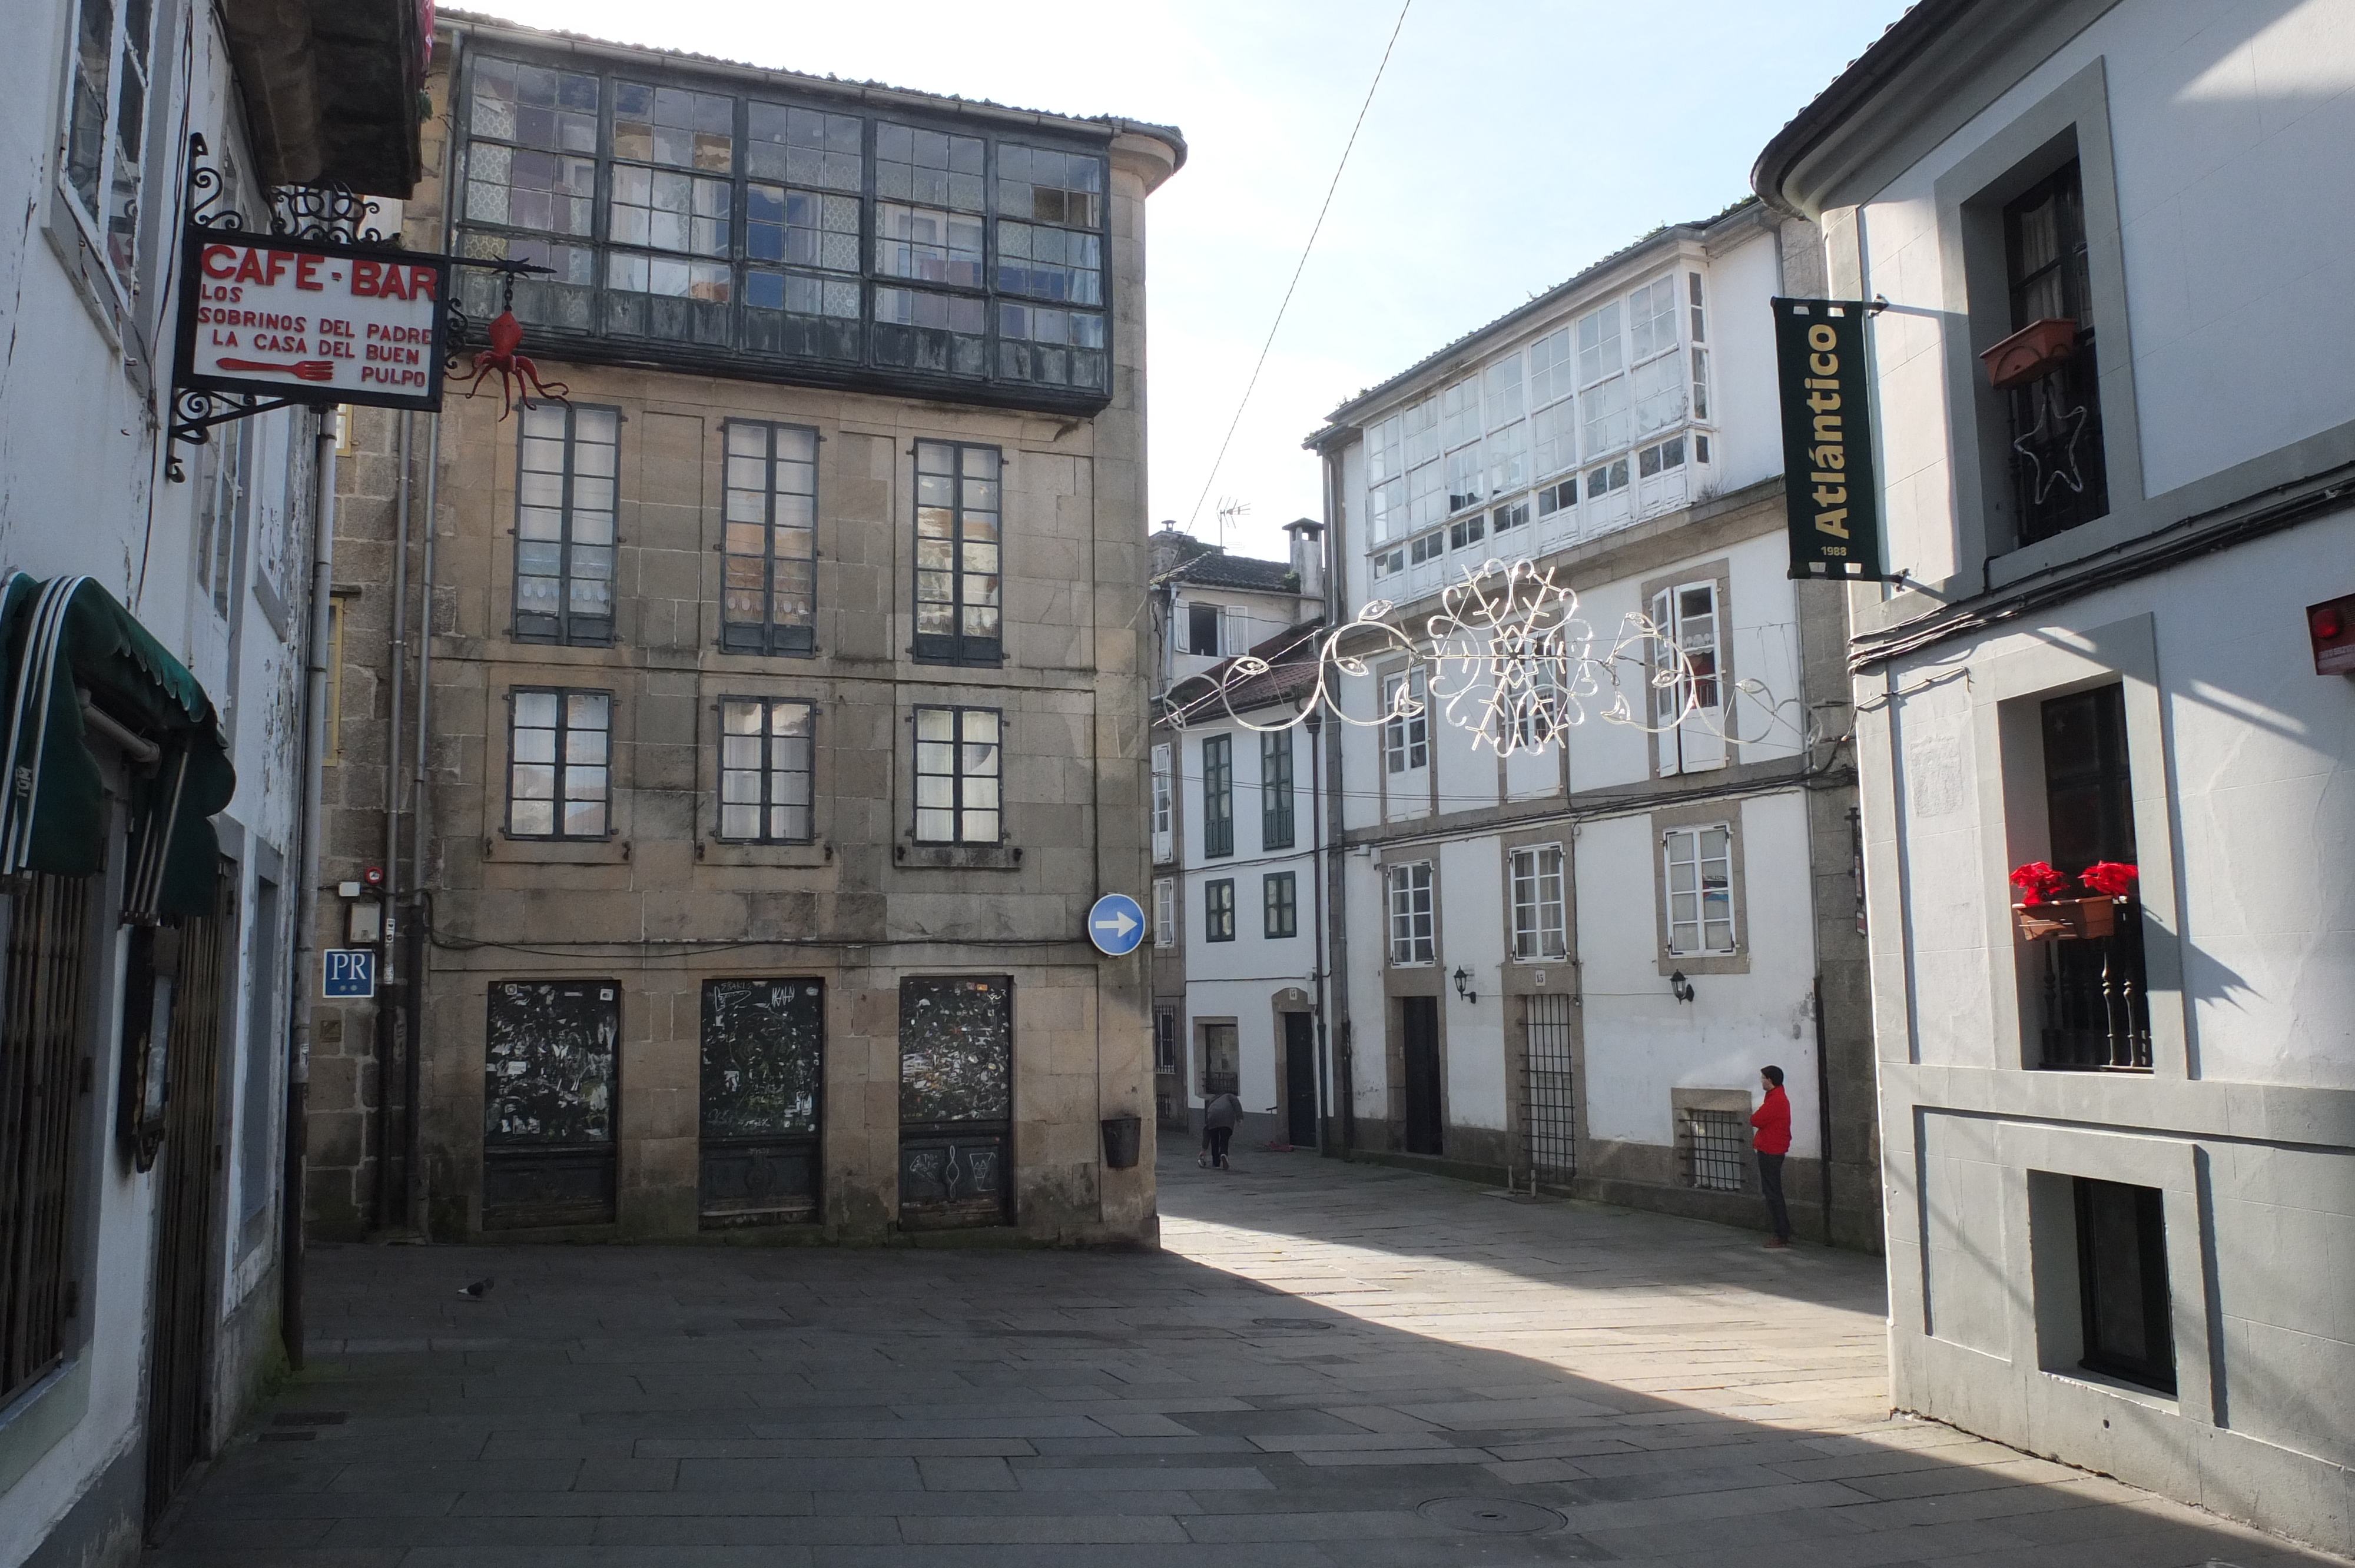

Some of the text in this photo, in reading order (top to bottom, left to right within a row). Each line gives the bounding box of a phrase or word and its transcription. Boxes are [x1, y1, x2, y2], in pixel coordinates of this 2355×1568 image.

[201, 284, 243, 303] LOS
[198, 307, 432, 344] SOBRINOS DEL PADRE
[213, 329, 419, 364] LA CASA DEL BUEN
[361, 366, 426, 387] PULPO
[1805, 324, 1849, 539] Atlántico
[1820, 546, 1847, 556] 1988
[331, 953, 367, 981] PR
